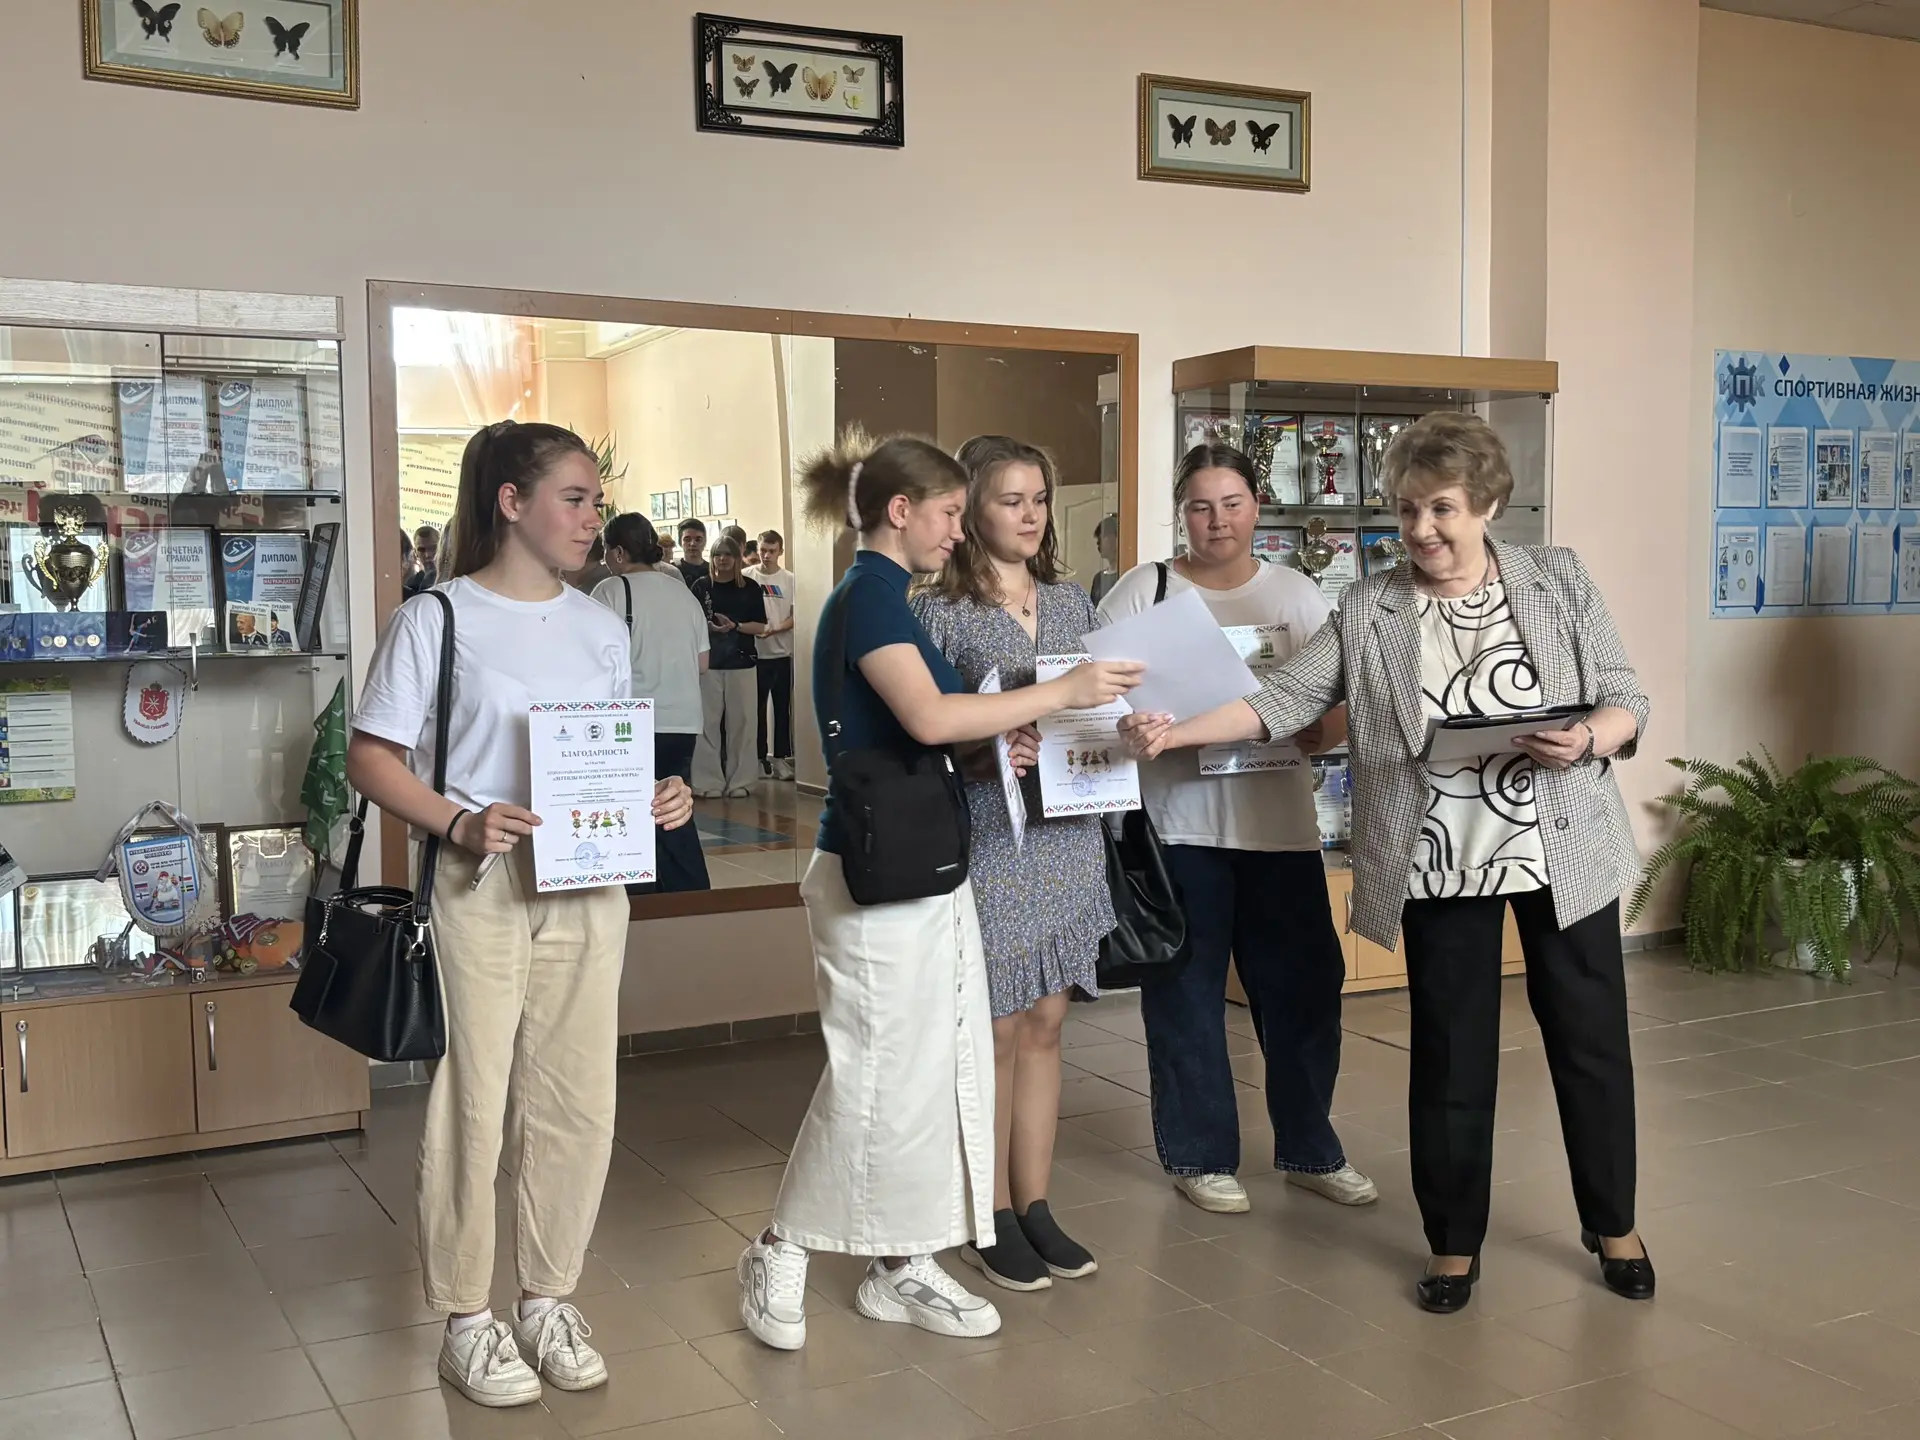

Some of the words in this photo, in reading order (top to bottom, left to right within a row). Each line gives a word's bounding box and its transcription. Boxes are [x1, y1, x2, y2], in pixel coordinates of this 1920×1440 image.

[1718, 373, 1766, 398] ИПК
[1774, 379, 1876, 401] СПОРТИВНАЯ
[159, 396, 198, 406] ДИПЛОМ
[256, 398, 293, 408] ДИПЛОМ
[161, 544, 204, 555] ПОЧЕТНАЯ
[166, 554, 200, 563] ГРАМОТА
[261, 552, 298, 564] ДИПЛОМ
[561, 748, 629, 758] БЛАГОДАРНОСТЬ
